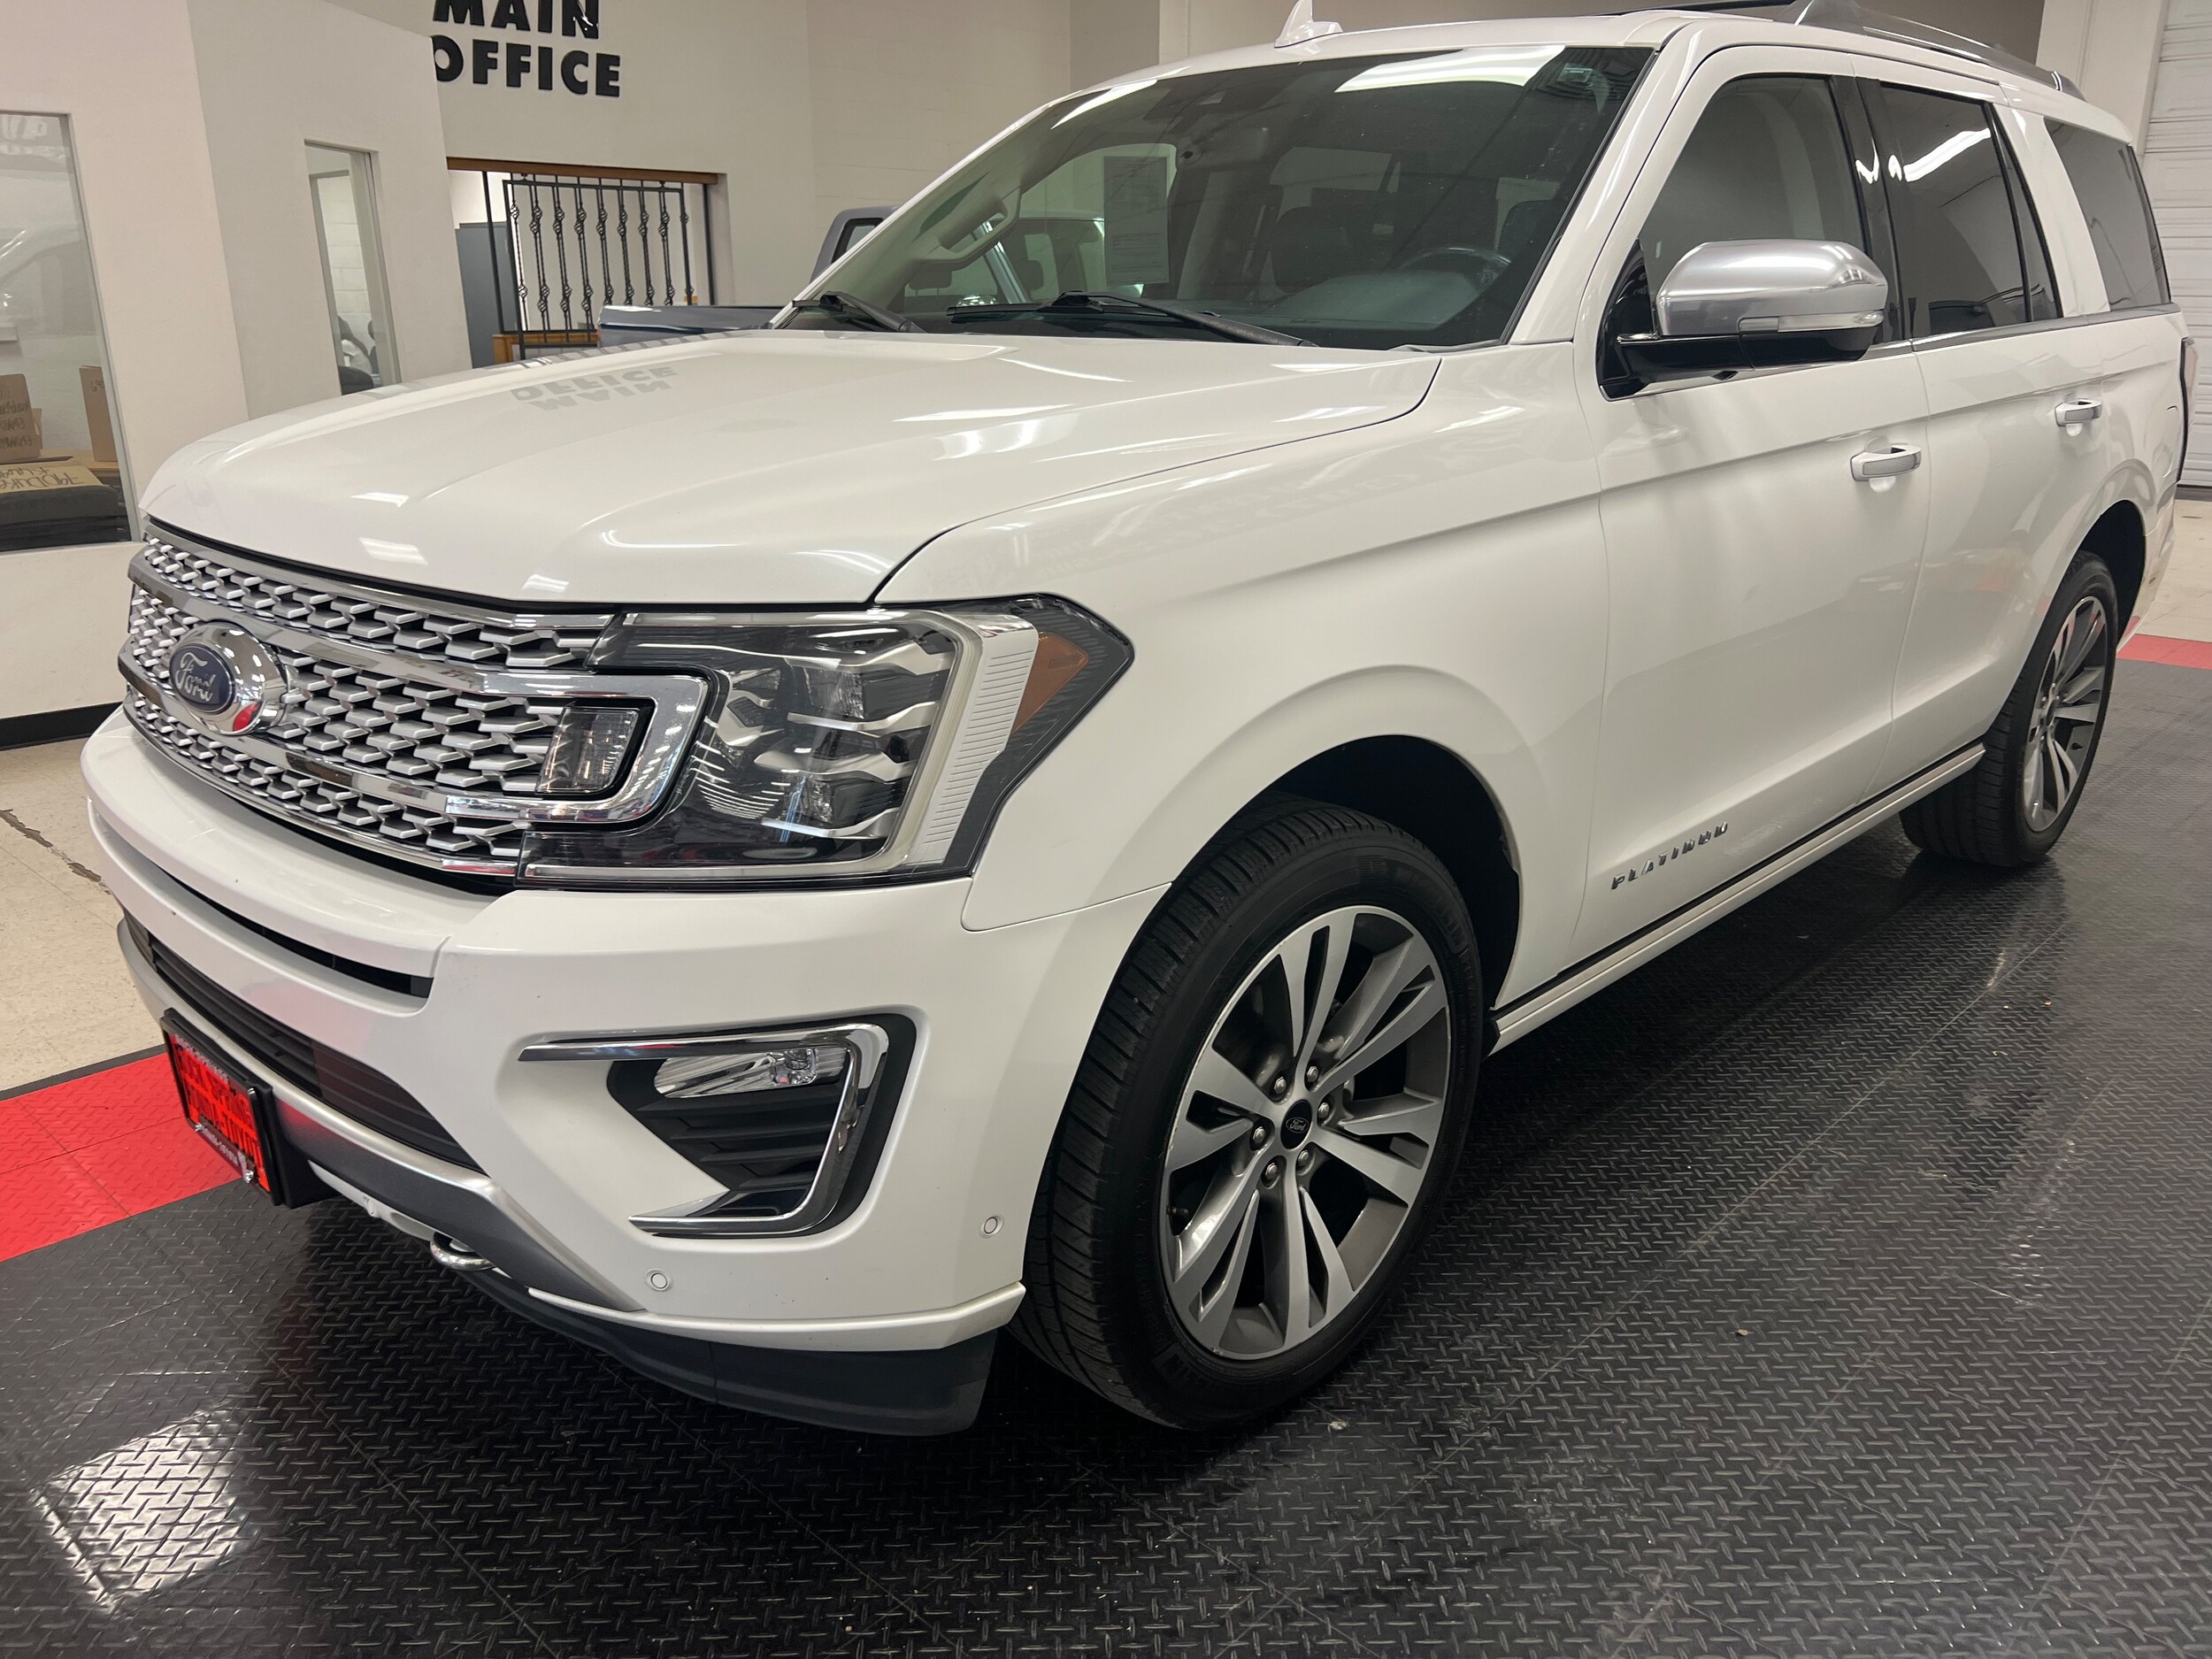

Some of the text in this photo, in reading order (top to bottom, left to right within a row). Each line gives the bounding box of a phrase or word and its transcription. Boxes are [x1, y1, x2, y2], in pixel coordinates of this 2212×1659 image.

[433, 0, 600, 39] MAIN
[430, 35, 620, 97] OFFICE
[176, 652, 217, 702] Ford
[1610, 821, 1728, 890] PLATINUM
[1289, 1118, 1307, 1132] Ford
